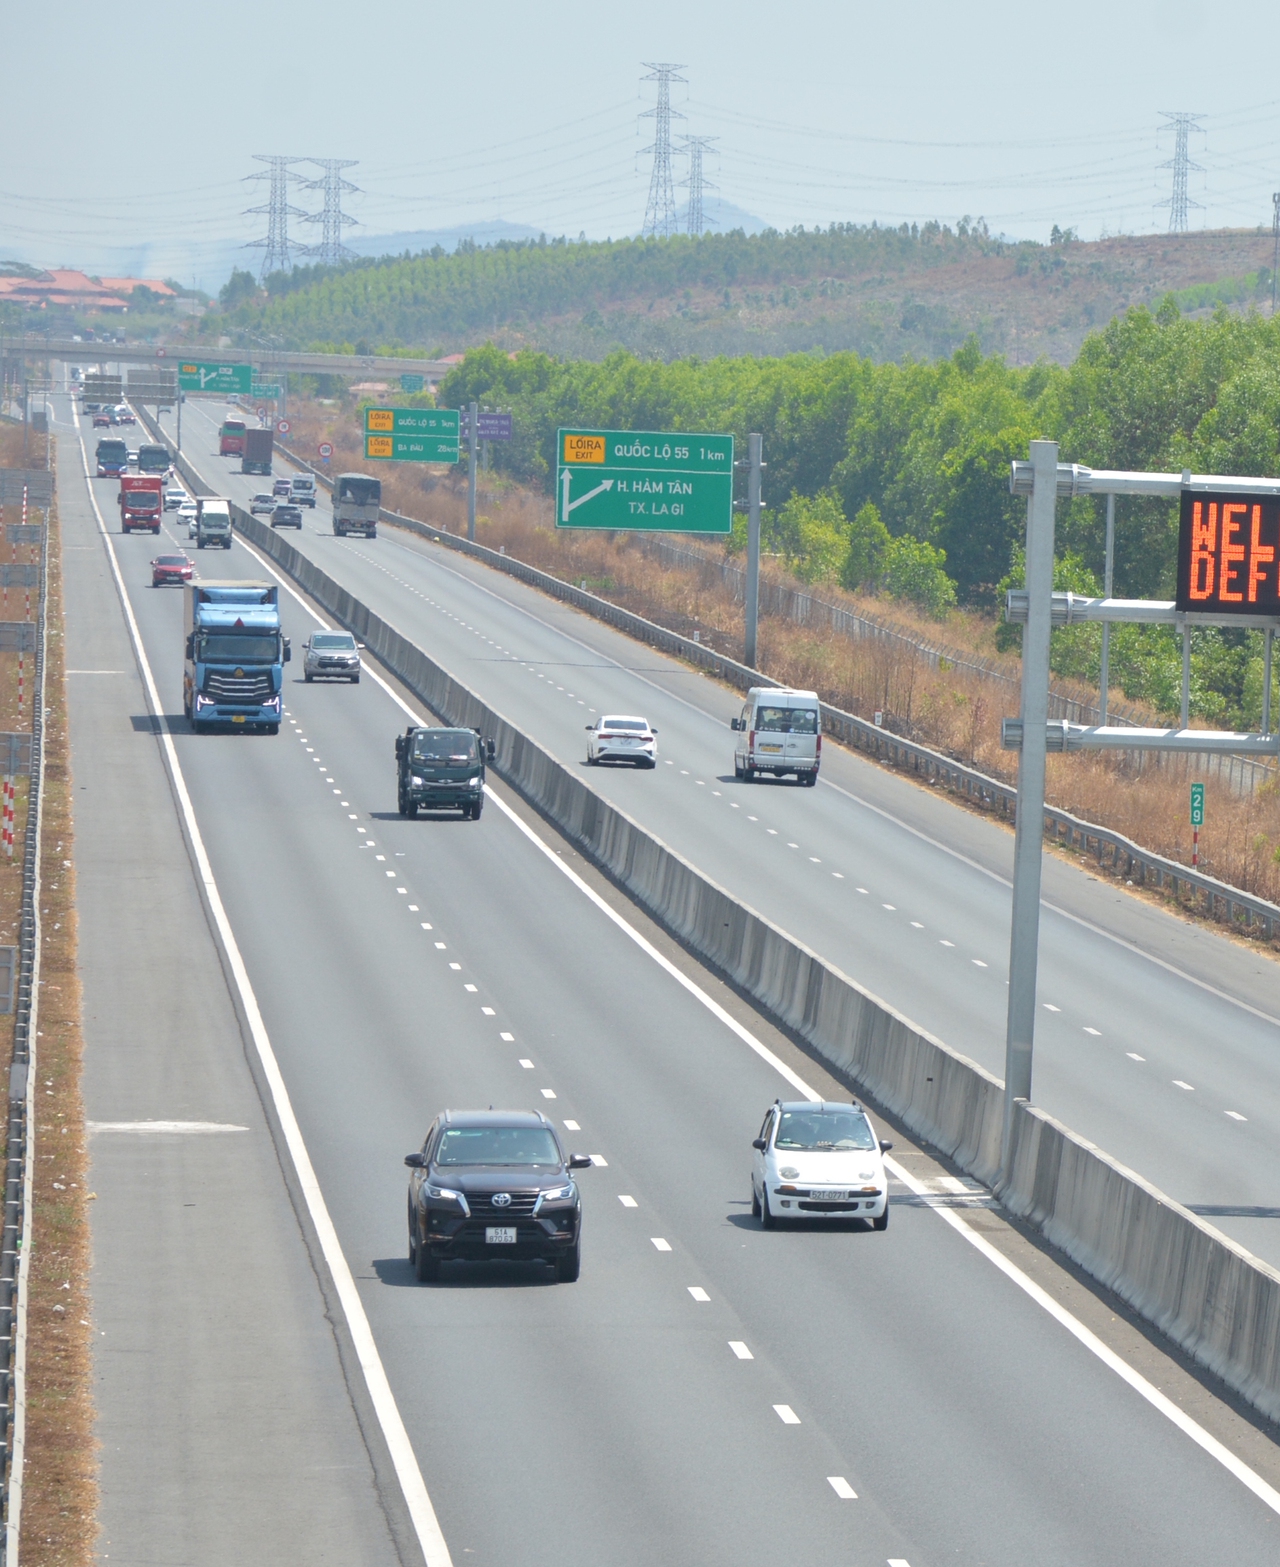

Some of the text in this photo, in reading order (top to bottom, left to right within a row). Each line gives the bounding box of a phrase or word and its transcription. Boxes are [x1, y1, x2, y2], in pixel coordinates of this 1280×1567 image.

[575, 451, 594, 460] EXIT
[614, 439, 651, 458] QUỐC
[654, 444, 671, 461] LỘ
[674, 447, 689, 459] 55
[617, 478, 693, 495] H. HÀM TÂN
[628, 502, 649, 515] TX.
